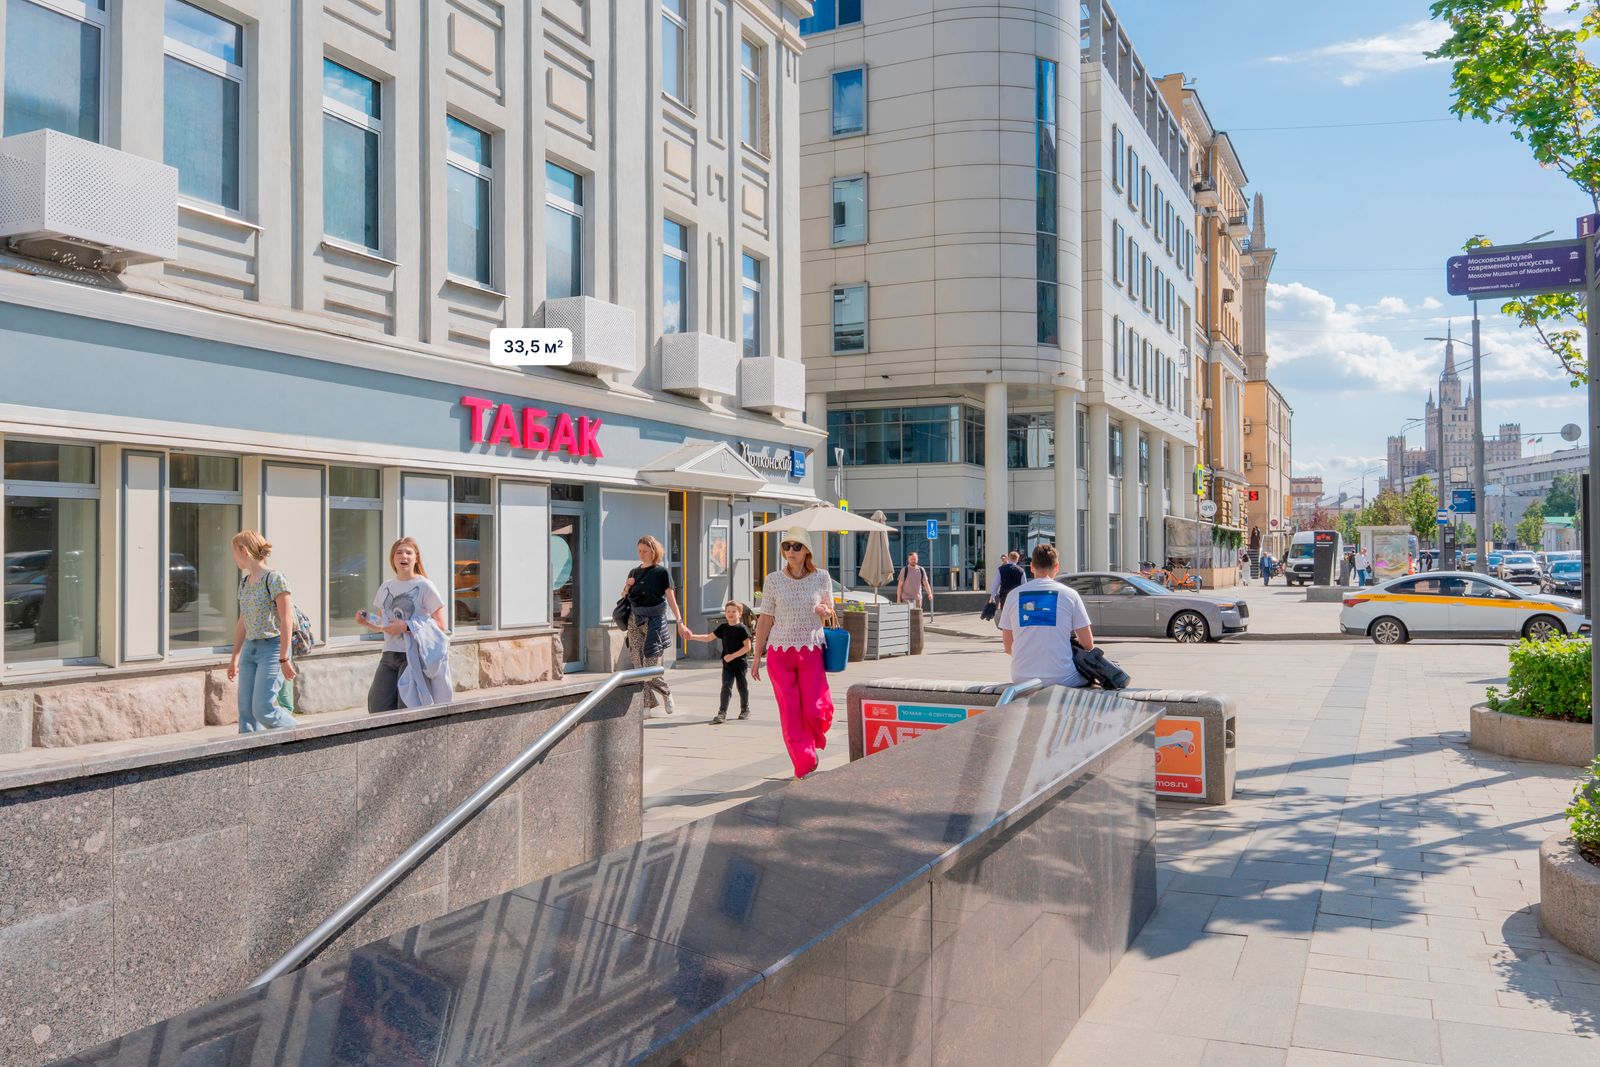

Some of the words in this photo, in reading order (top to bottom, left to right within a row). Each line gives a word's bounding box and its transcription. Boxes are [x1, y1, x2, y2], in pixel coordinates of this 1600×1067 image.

[1468, 256, 1510, 264] Московский
[1511, 253, 1533, 262] музей
[1468, 263, 1518, 271] современного
[1519, 259, 1554, 268] искусства
[1526, 267, 1551, 275] Modern
[460, 396, 604, 459] ТАБАК
